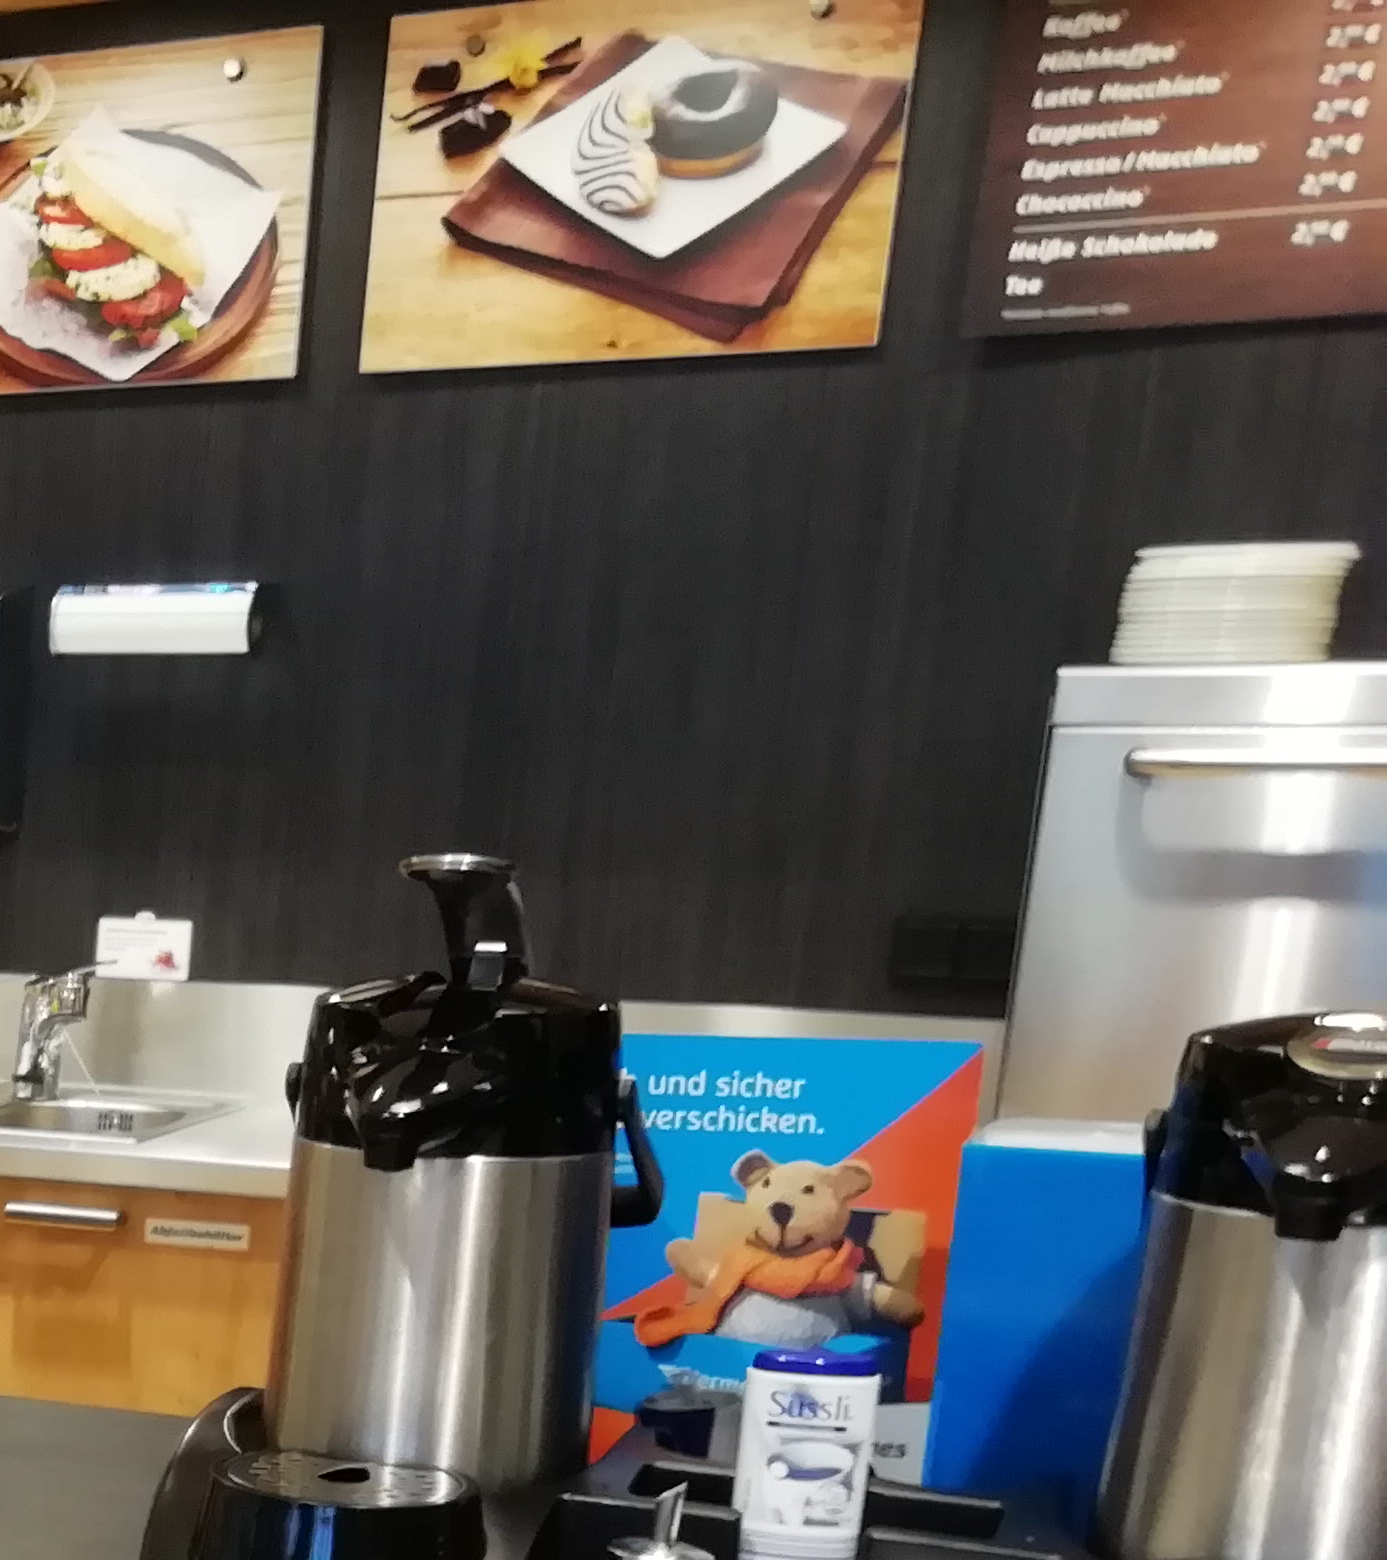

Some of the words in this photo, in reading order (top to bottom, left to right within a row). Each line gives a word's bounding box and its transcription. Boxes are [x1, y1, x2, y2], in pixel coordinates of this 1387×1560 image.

[648, 1070, 706, 1097] und
[716, 1070, 806, 1099] sicher
[642, 1106, 825, 1135] verschicken.
